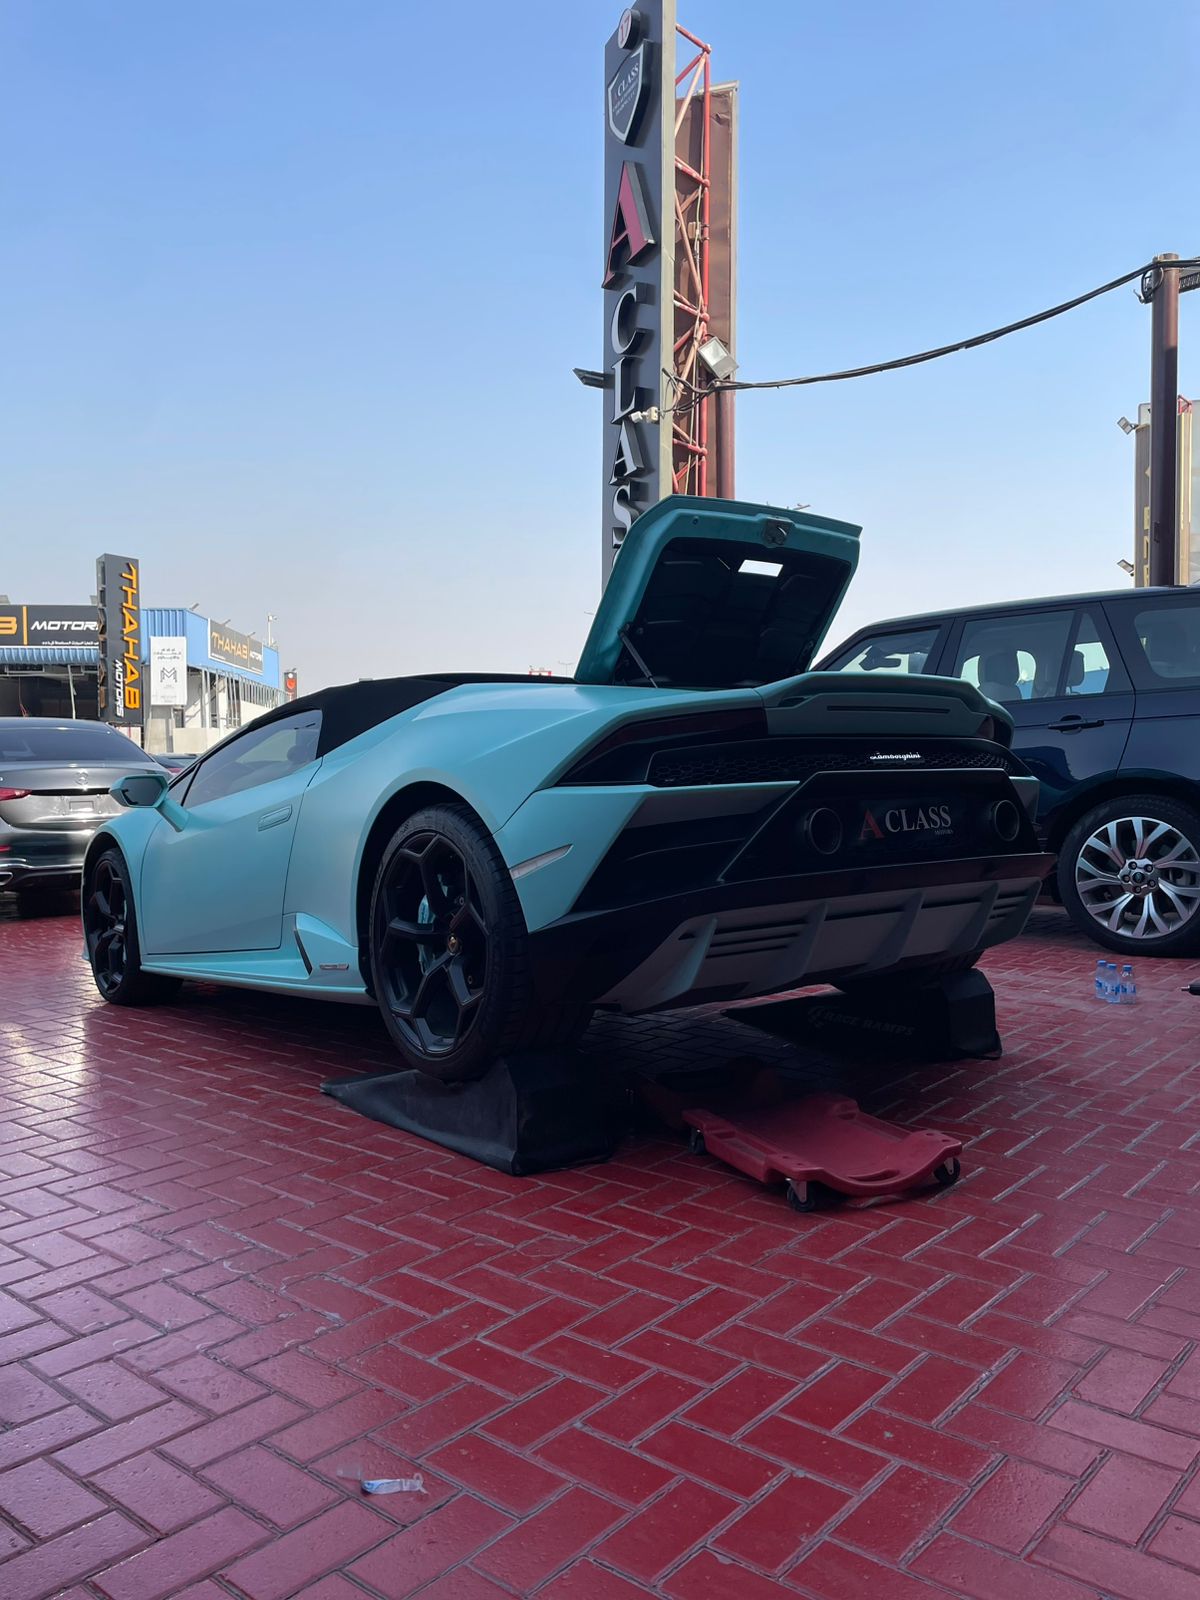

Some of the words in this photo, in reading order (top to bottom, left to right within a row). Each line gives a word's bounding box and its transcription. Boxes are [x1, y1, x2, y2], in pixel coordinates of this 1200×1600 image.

[617, 62, 640, 97] CLASS
[610, 283, 646, 567] CLAS
[120, 562, 141, 710] THAHAB
[211, 631, 249, 660] THAHAB
[113, 659, 125, 718] MOTORS
[869, 751, 922, 761] Lamborghini
[858, 809, 885, 841] A
[885, 805, 952, 833] CLASS
